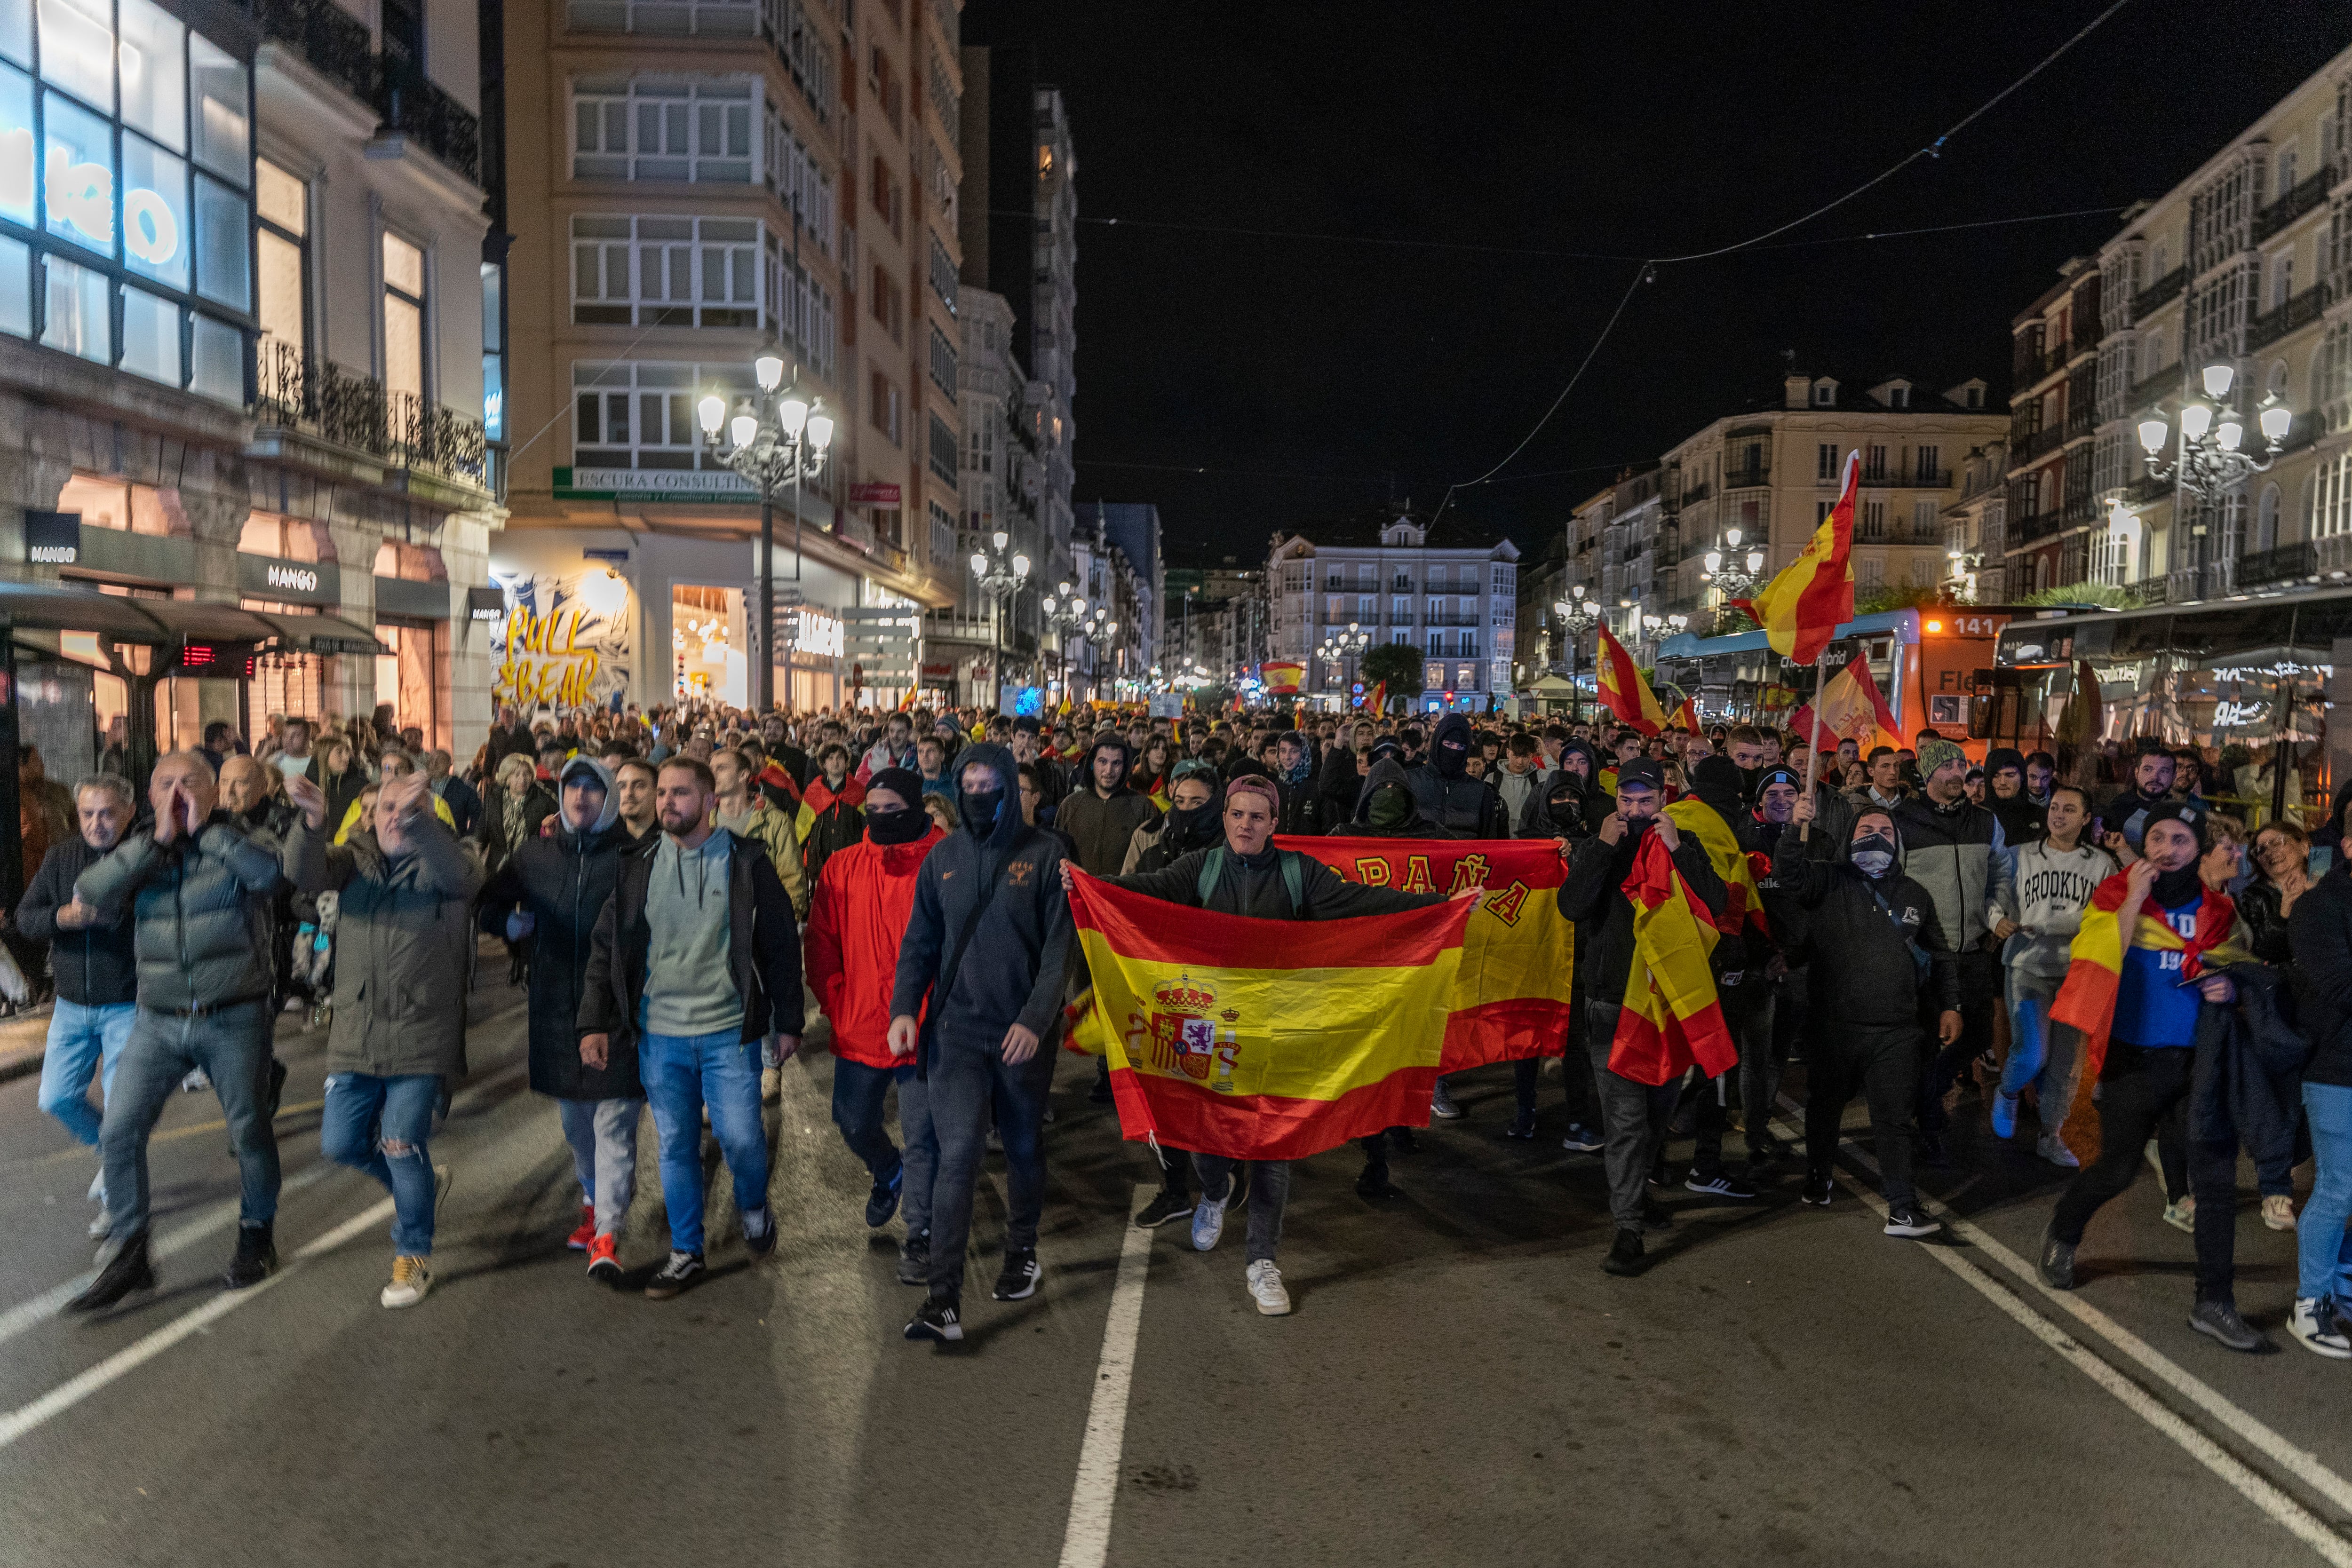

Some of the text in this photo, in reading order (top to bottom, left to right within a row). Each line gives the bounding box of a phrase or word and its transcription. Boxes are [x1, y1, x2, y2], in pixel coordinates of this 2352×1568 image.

[579, 472, 756, 491] ESCURA CONSULTIN
[31, 546, 76, 563] MANGO
[268, 564, 318, 592] MANGO
[472, 608, 502, 620] MANGO
[1955, 618, 1994, 634] 141
[1815, 649, 1847, 666] hbrid
[1939, 670, 1991, 691] Fle
[1329, 853, 1531, 927] PAÑA
[1757, 878, 1780, 889] elle
[2159, 950, 2204, 971] 19
